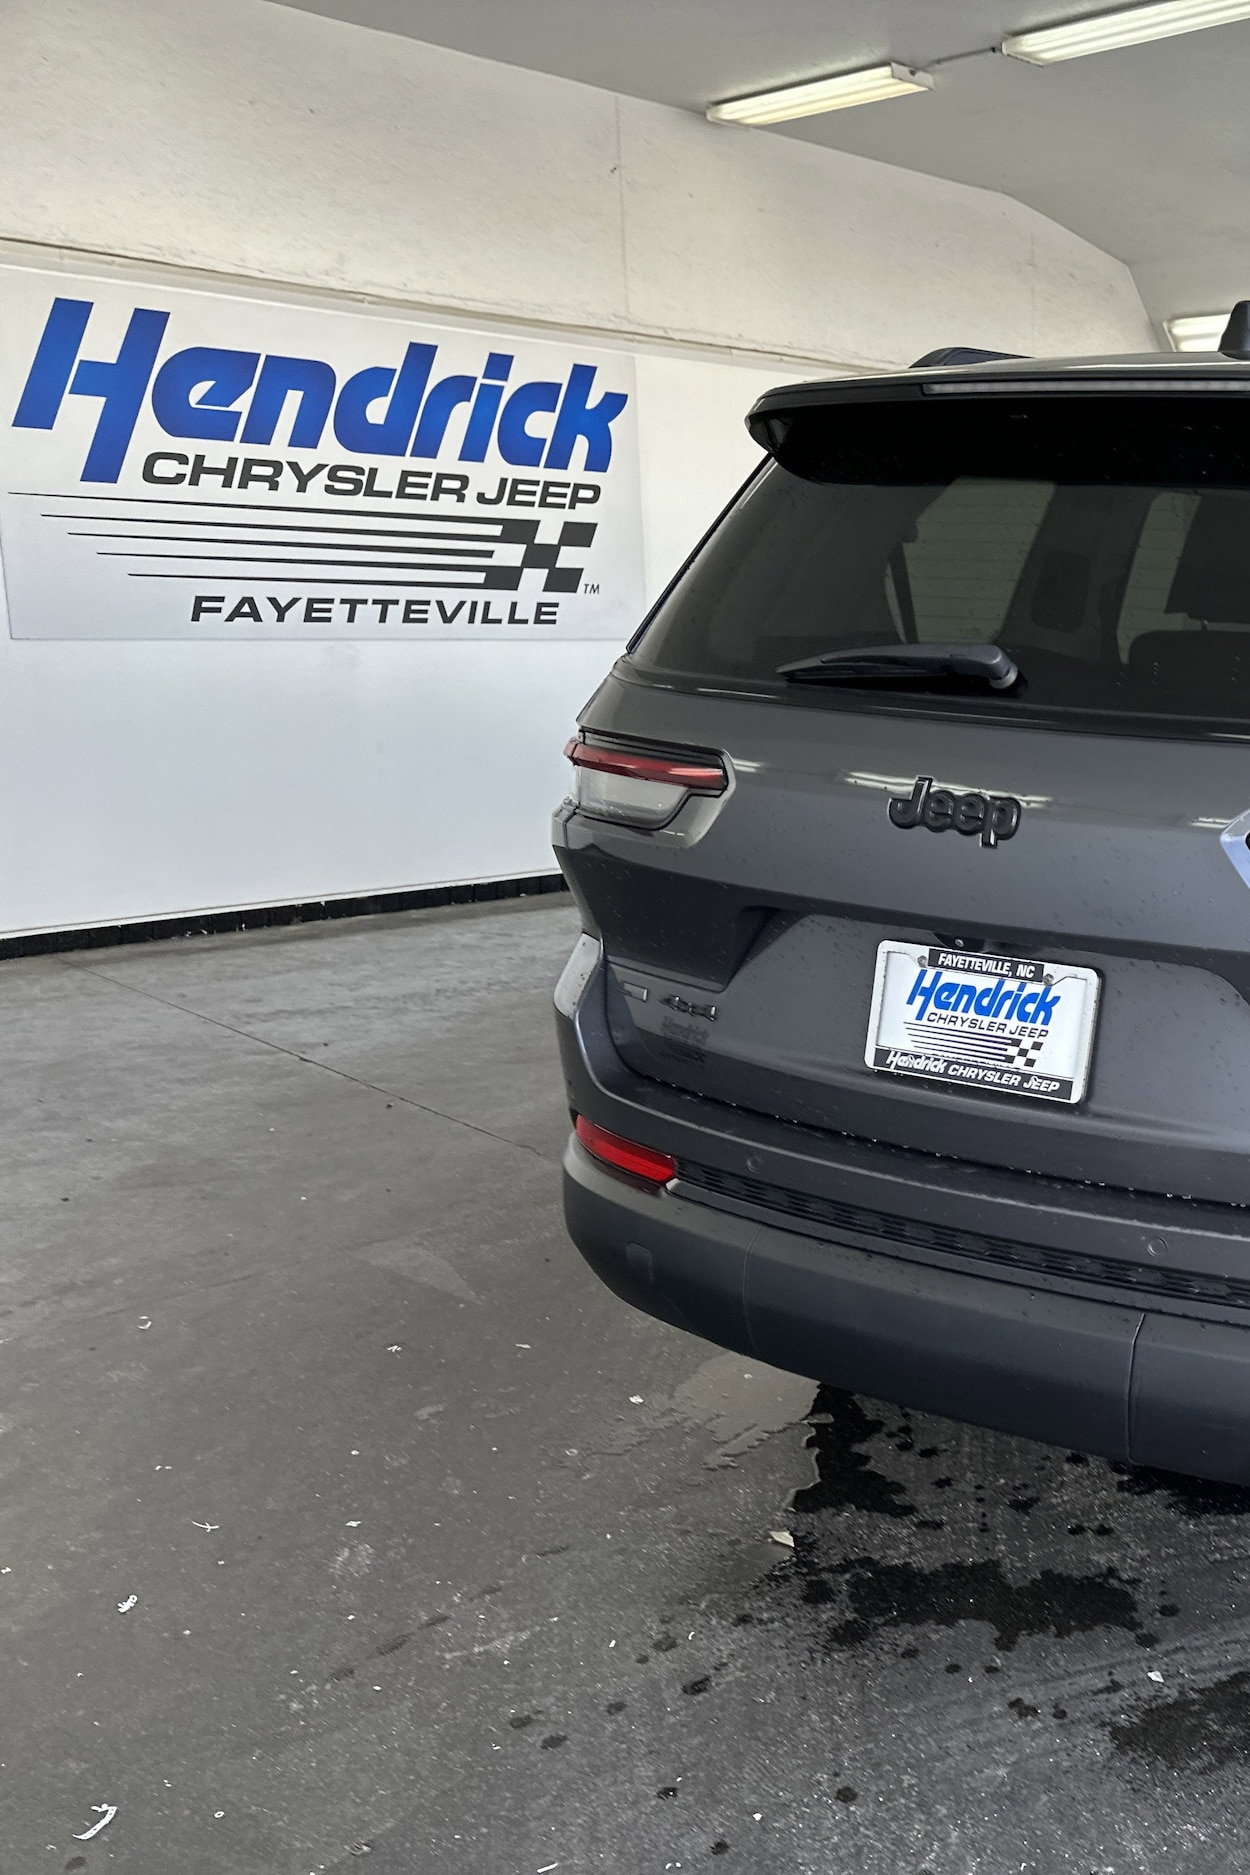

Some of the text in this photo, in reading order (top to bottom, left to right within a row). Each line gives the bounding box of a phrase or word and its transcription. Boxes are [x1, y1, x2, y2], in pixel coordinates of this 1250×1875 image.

[12, 297, 629, 484] Hendrick
[142, 451, 602, 510] CHRYSLER JEEP
[190, 596, 559, 625] FAYETTEVILLE
[887, 776, 1021, 848] Jeep
[938, 953, 1036, 979] FAYETTEVILLE, NC
[906, 969, 1061, 1026] Hendrick
[927, 1012, 1049, 1040] CHRYSLER JEEP
[886, 1051, 1060, 1092] Hendrick CHRYSLER JEEP
